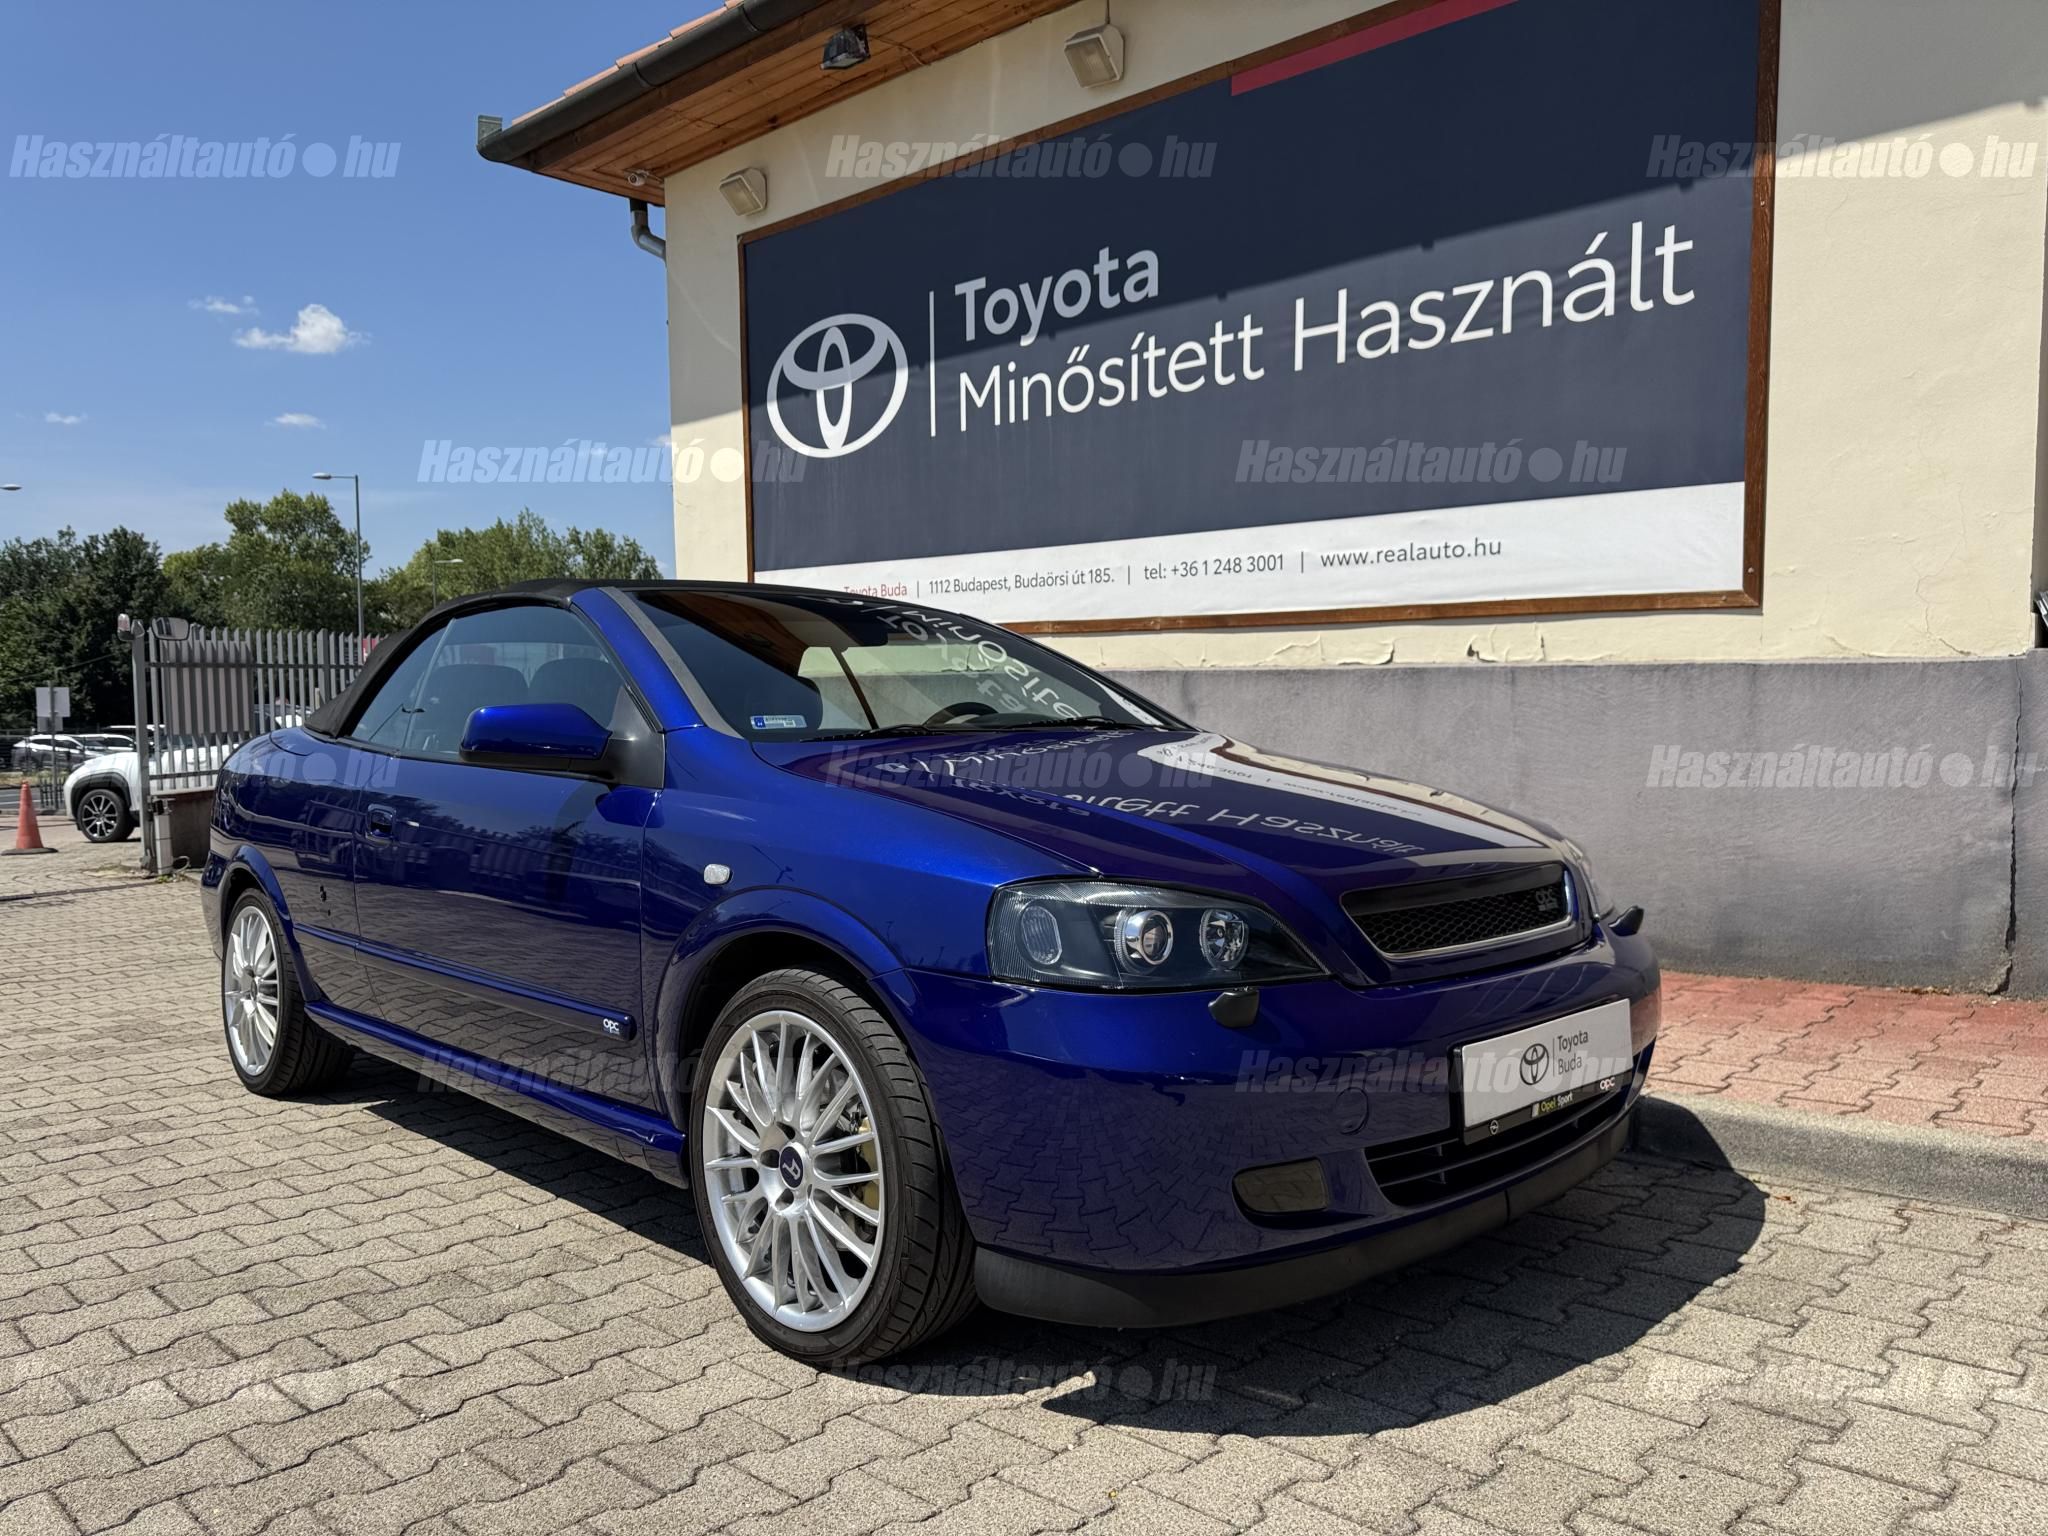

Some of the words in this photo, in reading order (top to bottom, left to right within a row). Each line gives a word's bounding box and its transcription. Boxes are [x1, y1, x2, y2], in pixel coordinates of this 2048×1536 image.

[955, 246, 1159, 347] Toyota
[959, 314, 1265, 432] Minősített
[1294, 221, 1695, 371] Használt
[880, 582, 907, 597] Buda
[929, 578, 951, 594] 1112
[953, 575, 1011, 597] Budapest,
[1014, 570, 1069, 589] Budaörsi
[1072, 568, 1085, 585] út
[1088, 567, 1115, 584] 185.
[1143, 563, 1167, 581] tel:
[1213, 557, 1242, 575] 248
[1246, 553, 1285, 573] 3001
[1320, 537, 1502, 567] www.realauto.hu
[1557, 1029, 1589, 1053] Toyota
[1557, 1055, 1583, 1076] Buda
[1540, 1098, 1557, 1114] Opel
[1557, 1091, 1573, 1109] Sport
